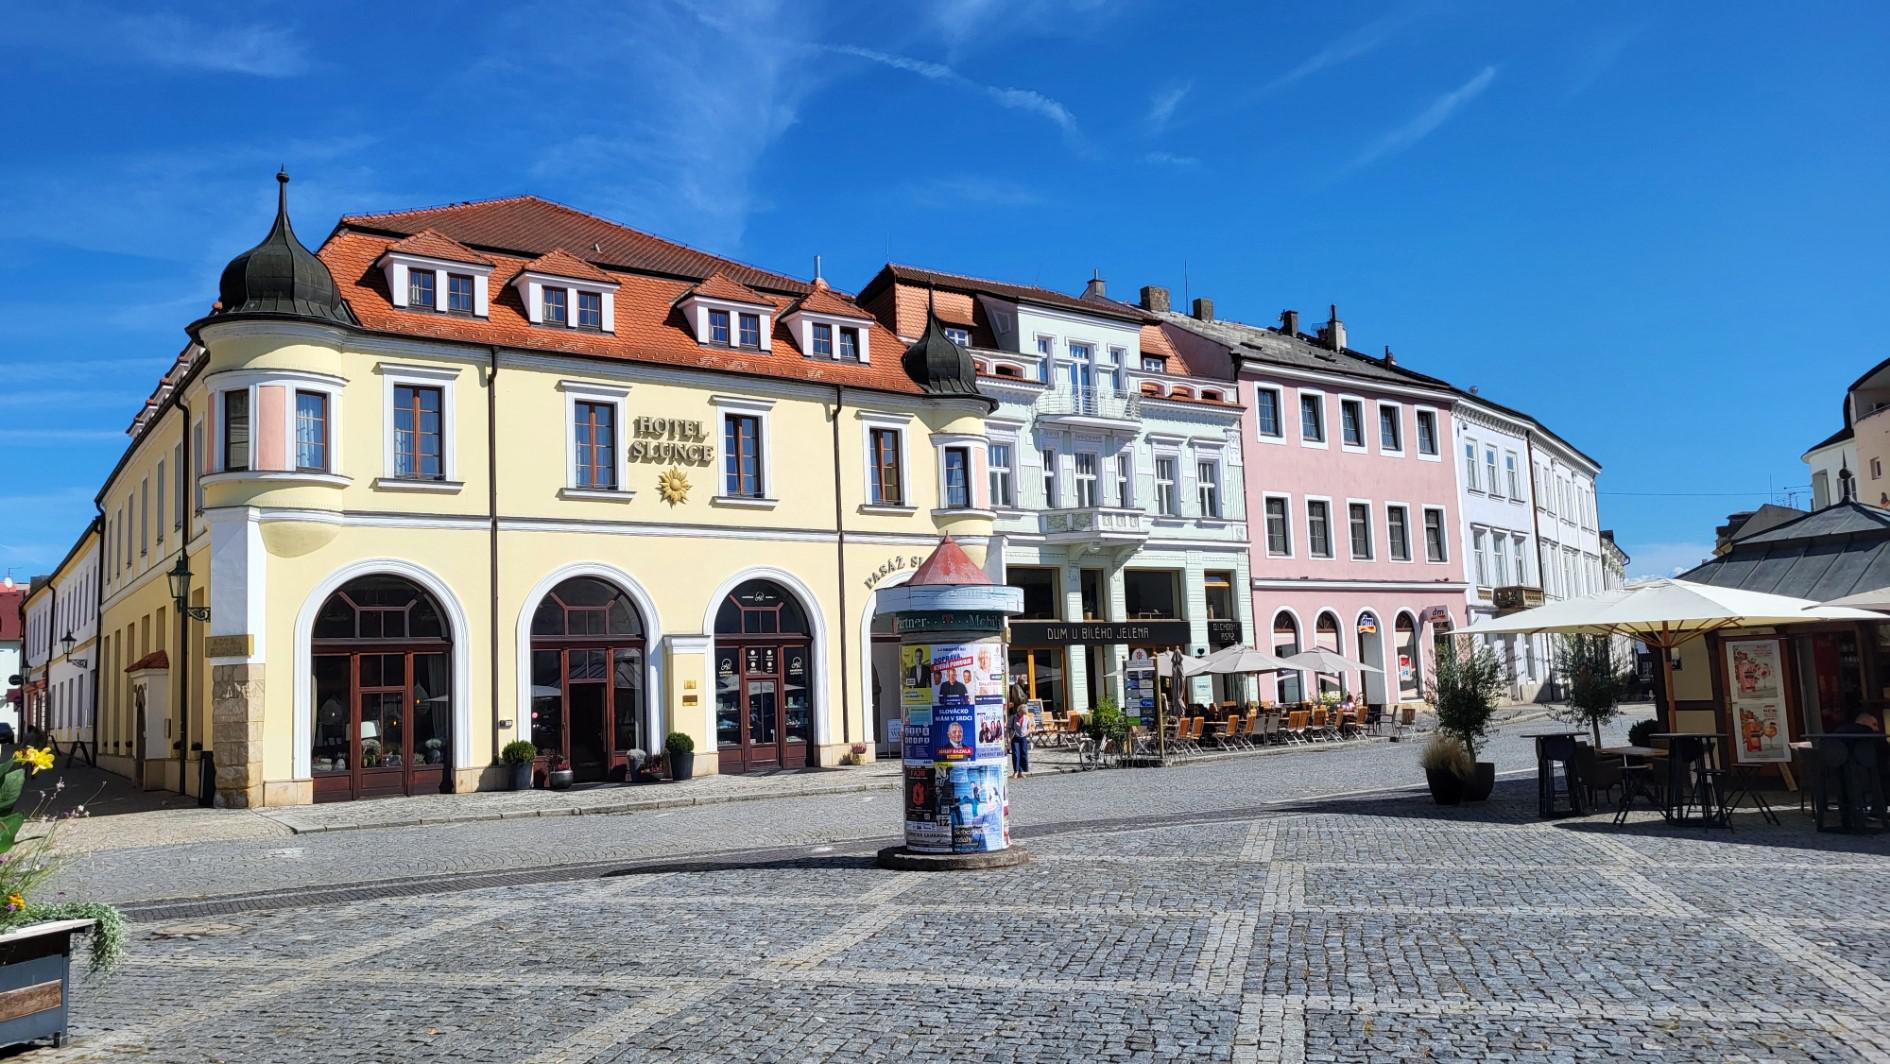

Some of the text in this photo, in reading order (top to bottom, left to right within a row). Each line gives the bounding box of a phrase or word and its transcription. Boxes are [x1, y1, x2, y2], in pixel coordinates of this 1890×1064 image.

[635, 416, 709, 441] HOTEL
[630, 440, 714, 463] SLUNCE
[864, 556, 905, 590] PASÁŽ
[1072, 628, 1078, 639] U
[1116, 627, 1149, 639] JELENA
